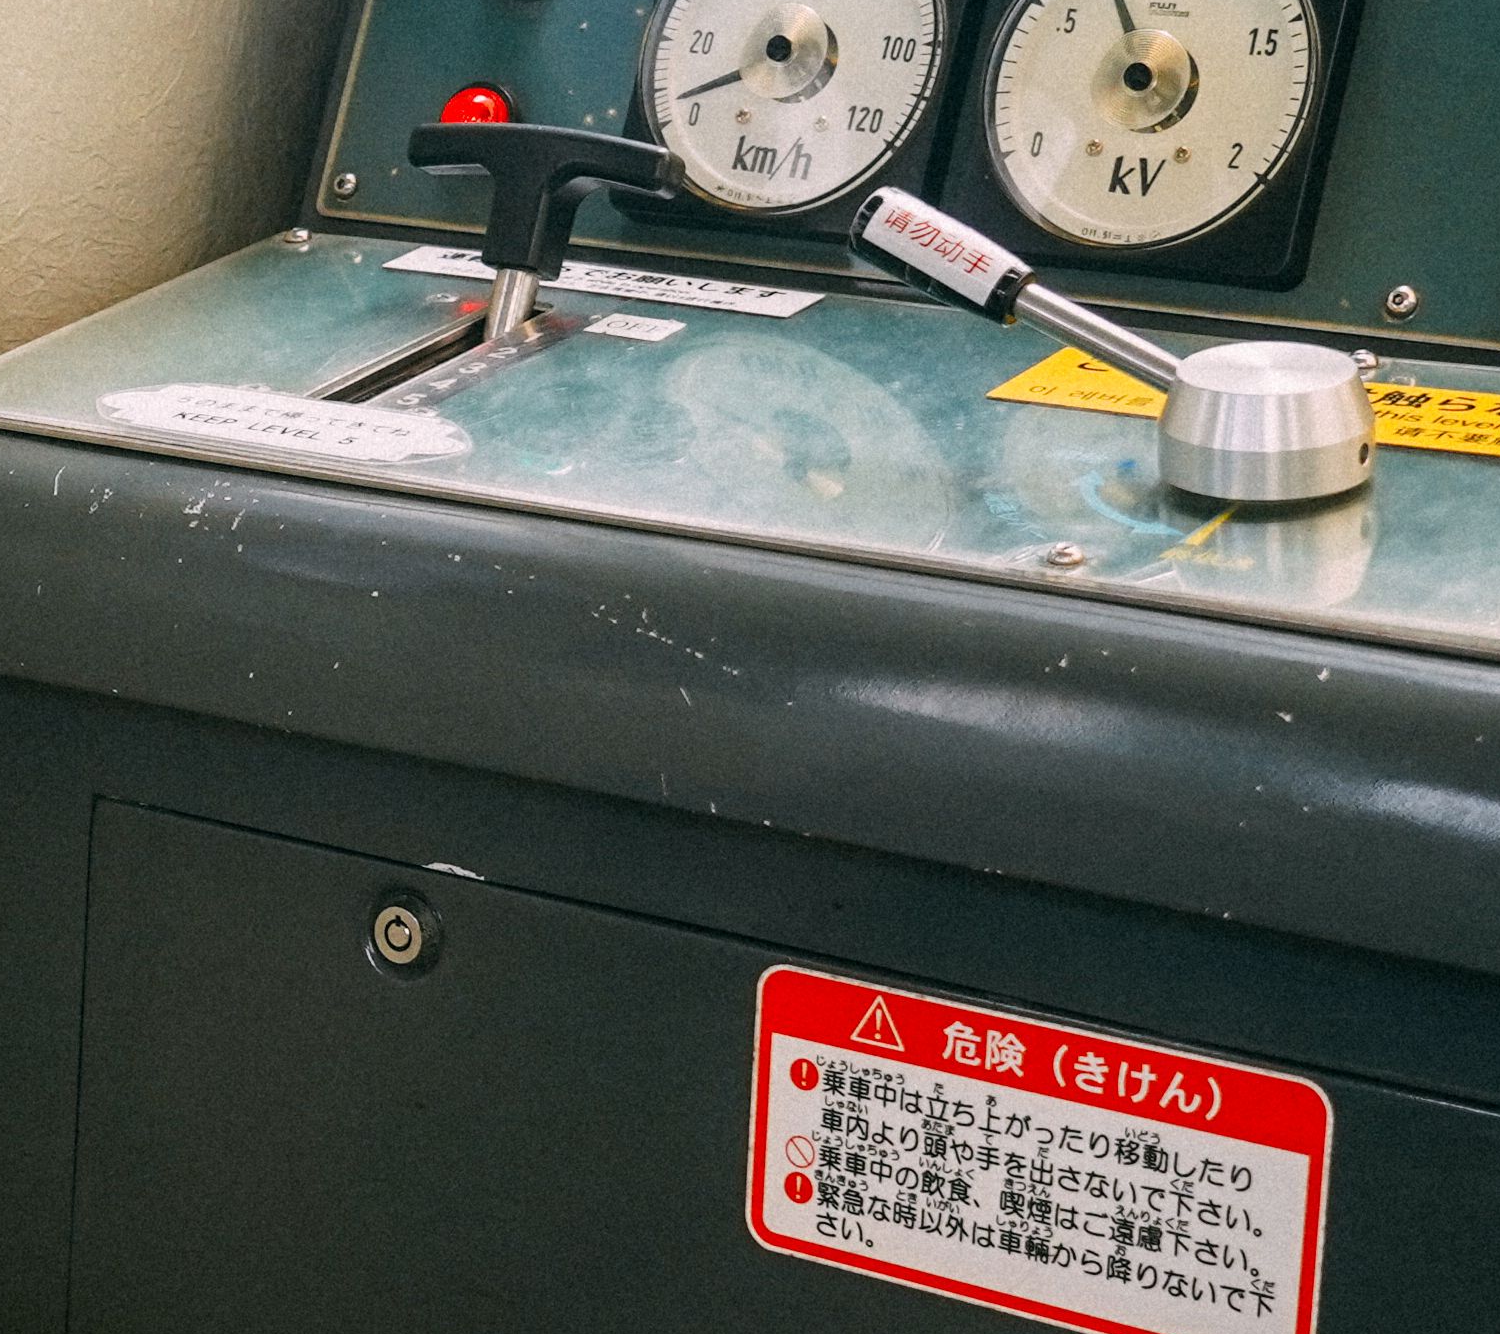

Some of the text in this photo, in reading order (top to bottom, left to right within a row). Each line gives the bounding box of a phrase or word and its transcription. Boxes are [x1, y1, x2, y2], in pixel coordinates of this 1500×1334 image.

[689, 30, 714, 55] 20
[881, 35, 916, 63] 100
[1248, 27, 1279, 56] 1.5
[688, 102, 700, 126] 0
[847, 105, 883, 134] 120
[732, 134, 812, 181] km/h
[1030, 131, 1043, 157] 0
[1227, 142, 1244, 169] 2
[1108, 155, 1166, 197] kV
[883, 208, 993, 276] 请勿动手
[173, 411, 360, 445] KEEP LEVEL 5
[816, 1212, 874, 1248] さい。
